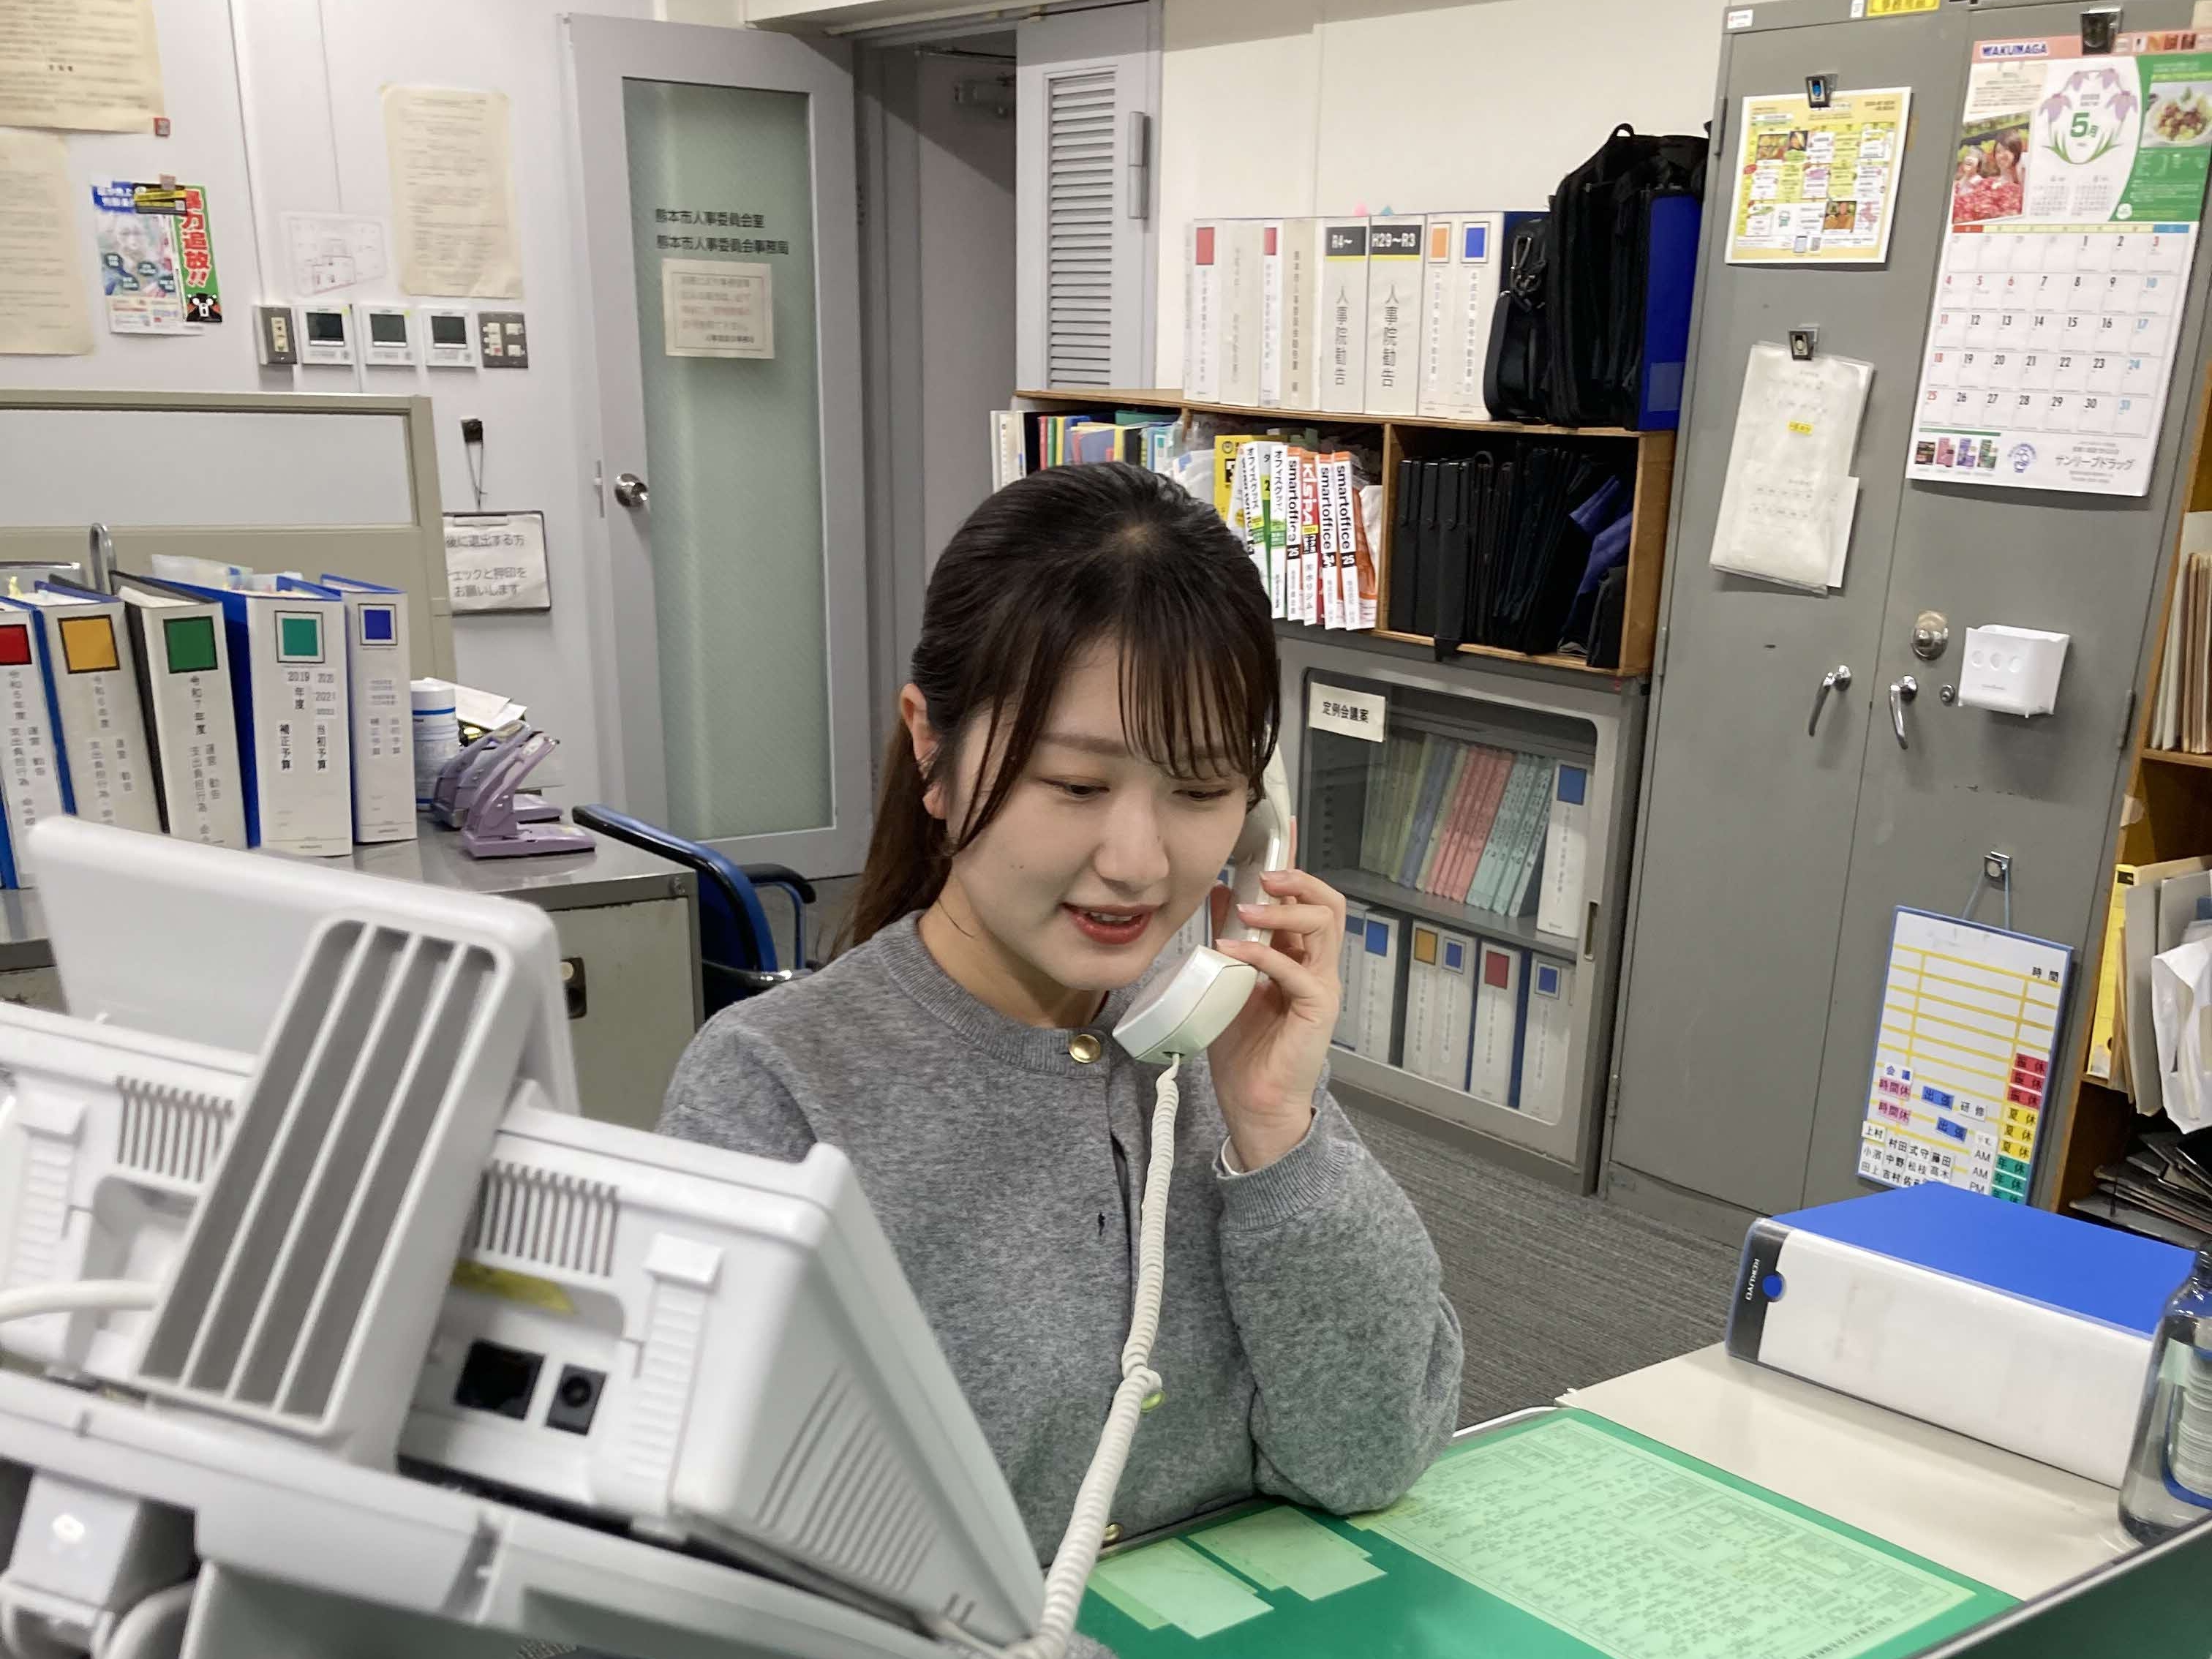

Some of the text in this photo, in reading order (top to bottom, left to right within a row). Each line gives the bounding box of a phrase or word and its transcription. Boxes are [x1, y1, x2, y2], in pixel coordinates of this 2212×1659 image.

[1982, 44, 2047, 56] WAKUNAGA
[2117, 236, 2123, 246] 2
[2041, 276, 2047, 286] 7
[2074, 277, 2081, 286] 8
[2110, 277, 2116, 286] 9
[1971, 315, 1980, 325] 12
[2002, 316, 2012, 326] 13
[2034, 316, 2044, 326] 14
[2067, 317, 2077, 327] 15
[2102, 317, 2113, 328] 16
[2137, 319, 2148, 329] 17
[1964, 353, 1974, 364] 19
[1994, 355, 2005, 365] 20
[2025, 356, 2036, 366] 21
[2059, 357, 2072, 367] 22
[2094, 358, 2105, 369] 23
[2129, 359, 2140, 369] 24
[1957, 392, 1967, 402] 26
[1987, 394, 1998, 404] 27
[2019, 395, 2031, 405] 28
[2052, 396, 2063, 407] 29
[2085, 398, 2097, 409] 30
[1287, 460, 1298, 542] smartoffice
[1321, 467, 1331, 549] smartoffice
[1336, 465, 1351, 549] smartoffice
[287, 672, 310, 682] 2019
[295, 688, 304, 710] 年度
[279, 723, 290, 771] 補正予算
[317, 724, 326, 771] 当初予算
[2009, 1107, 2036, 1125] 夏休
[1867, 1126, 1883, 1139] 上村
[2006, 1125, 2034, 1141] 夏休
[1889, 1138, 1908, 1152] 村田
[2003, 1141, 2030, 1158] 夏休
[1886, 1154, 1904, 1167] 中野
[1975, 1149, 1990, 1162] AM
[1861, 1162, 1879, 1175] 田上
[1973, 1167, 1988, 1179] AM
[1998, 1157, 2025, 1173] 年休
[1995, 1173, 2023, 1189] 年休
[1745, 1258, 1761, 1301] KOKUYO
